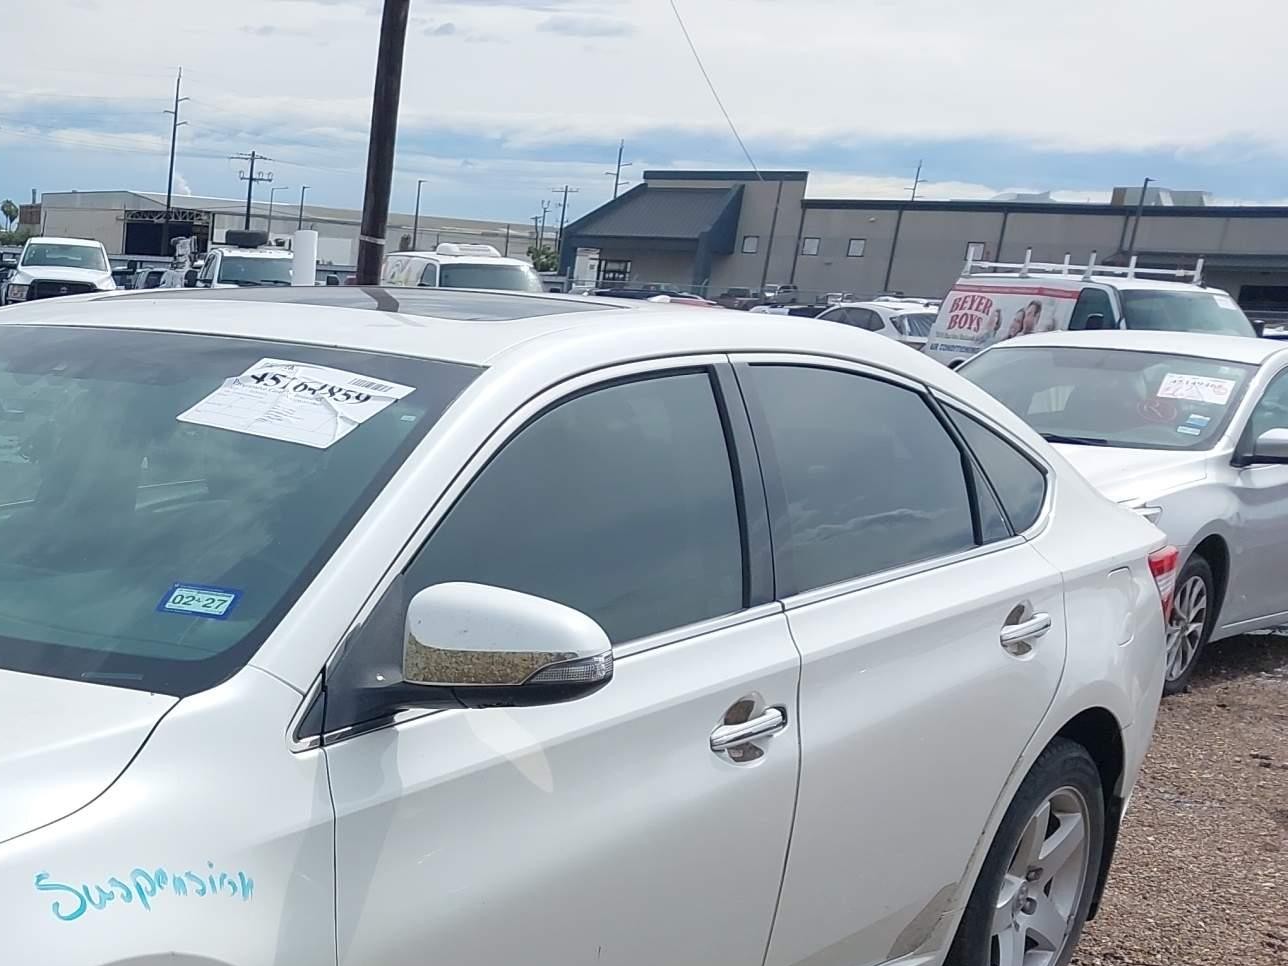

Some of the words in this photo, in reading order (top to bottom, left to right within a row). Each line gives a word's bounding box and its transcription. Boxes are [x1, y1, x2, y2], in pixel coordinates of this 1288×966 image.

[948, 294, 993, 317] BEYER
[947, 312, 983, 333] BOYS
[35, 860, 255, 921] Suspension
